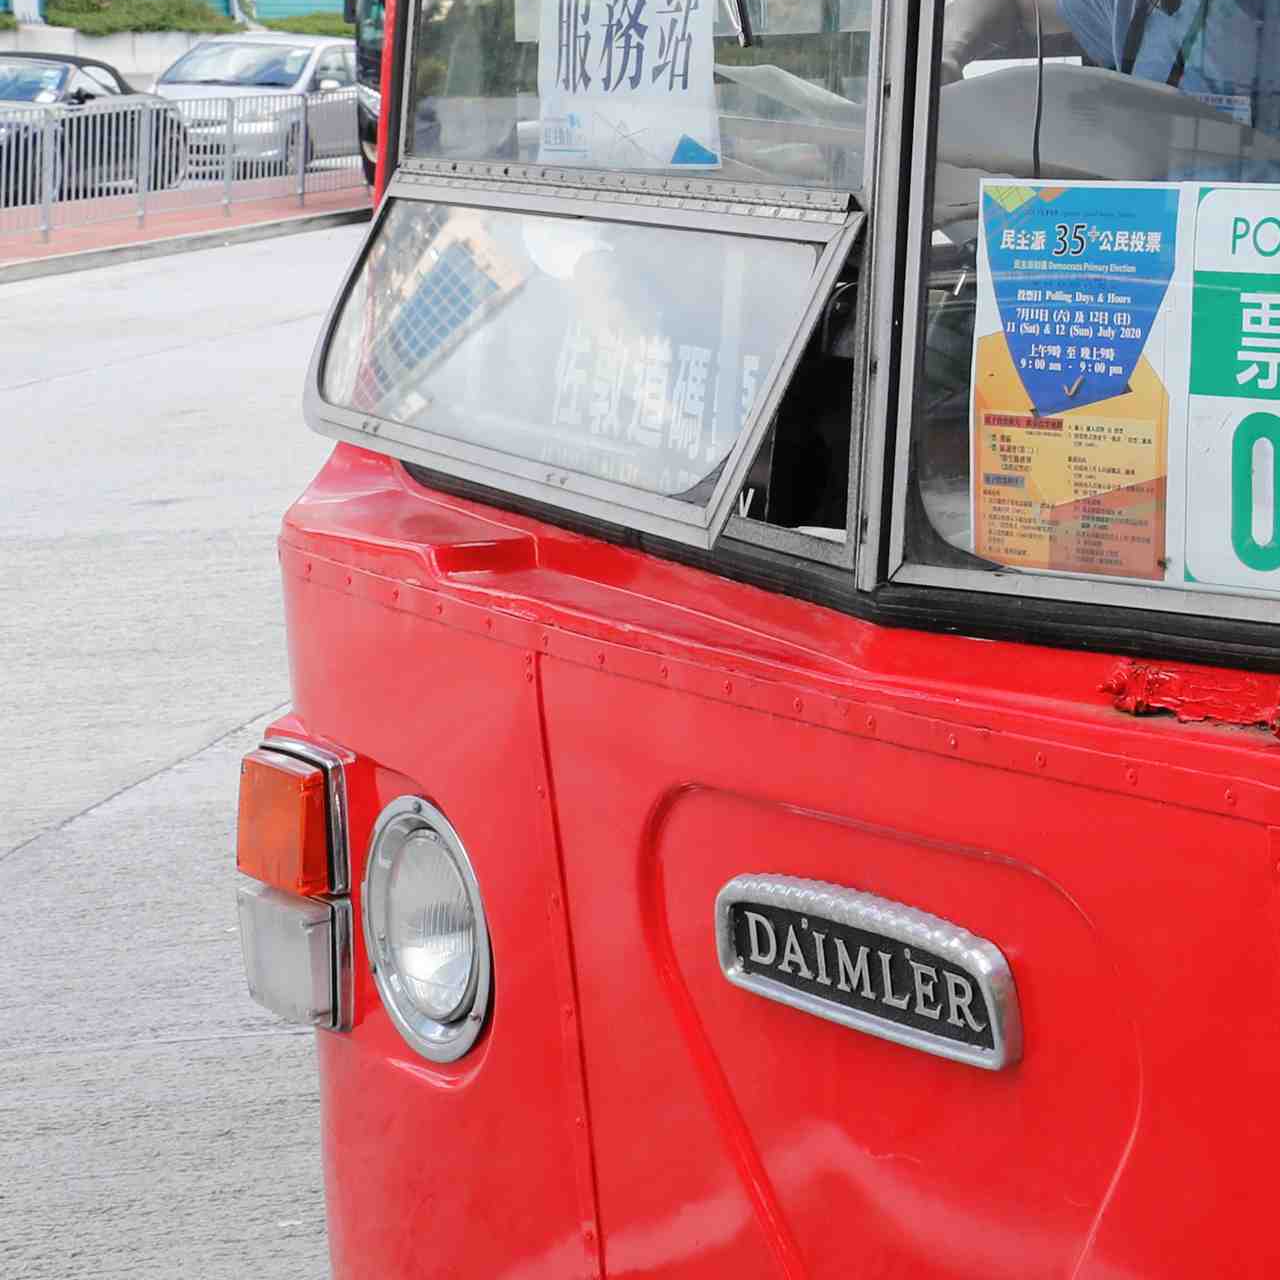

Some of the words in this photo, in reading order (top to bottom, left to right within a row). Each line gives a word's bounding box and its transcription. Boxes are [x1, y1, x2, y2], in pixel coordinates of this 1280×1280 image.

[1000, 229, 1047, 252] 民主派
[1099, 231, 1162, 253] 公民投票
[1046, 289, 1073, 304] Polling
[1076, 292, 1094, 304] Days
[1108, 293, 1132, 304] Hours
[1089, 311, 1109, 325] 12日
[1113, 312, 1132, 326] (日)
[1006, 322, 1016, 333] 11
[1019, 322, 1040, 336] (Sat)
[1043, 324, 1051, 335] &
[1056, 324, 1066, 335] 12
[1070, 325, 1093, 338] (Sun)
[1097, 326, 1116, 340] July
[1119, 327, 1142, 339] 2020
[743, 910, 988, 1033] DAIMLER
